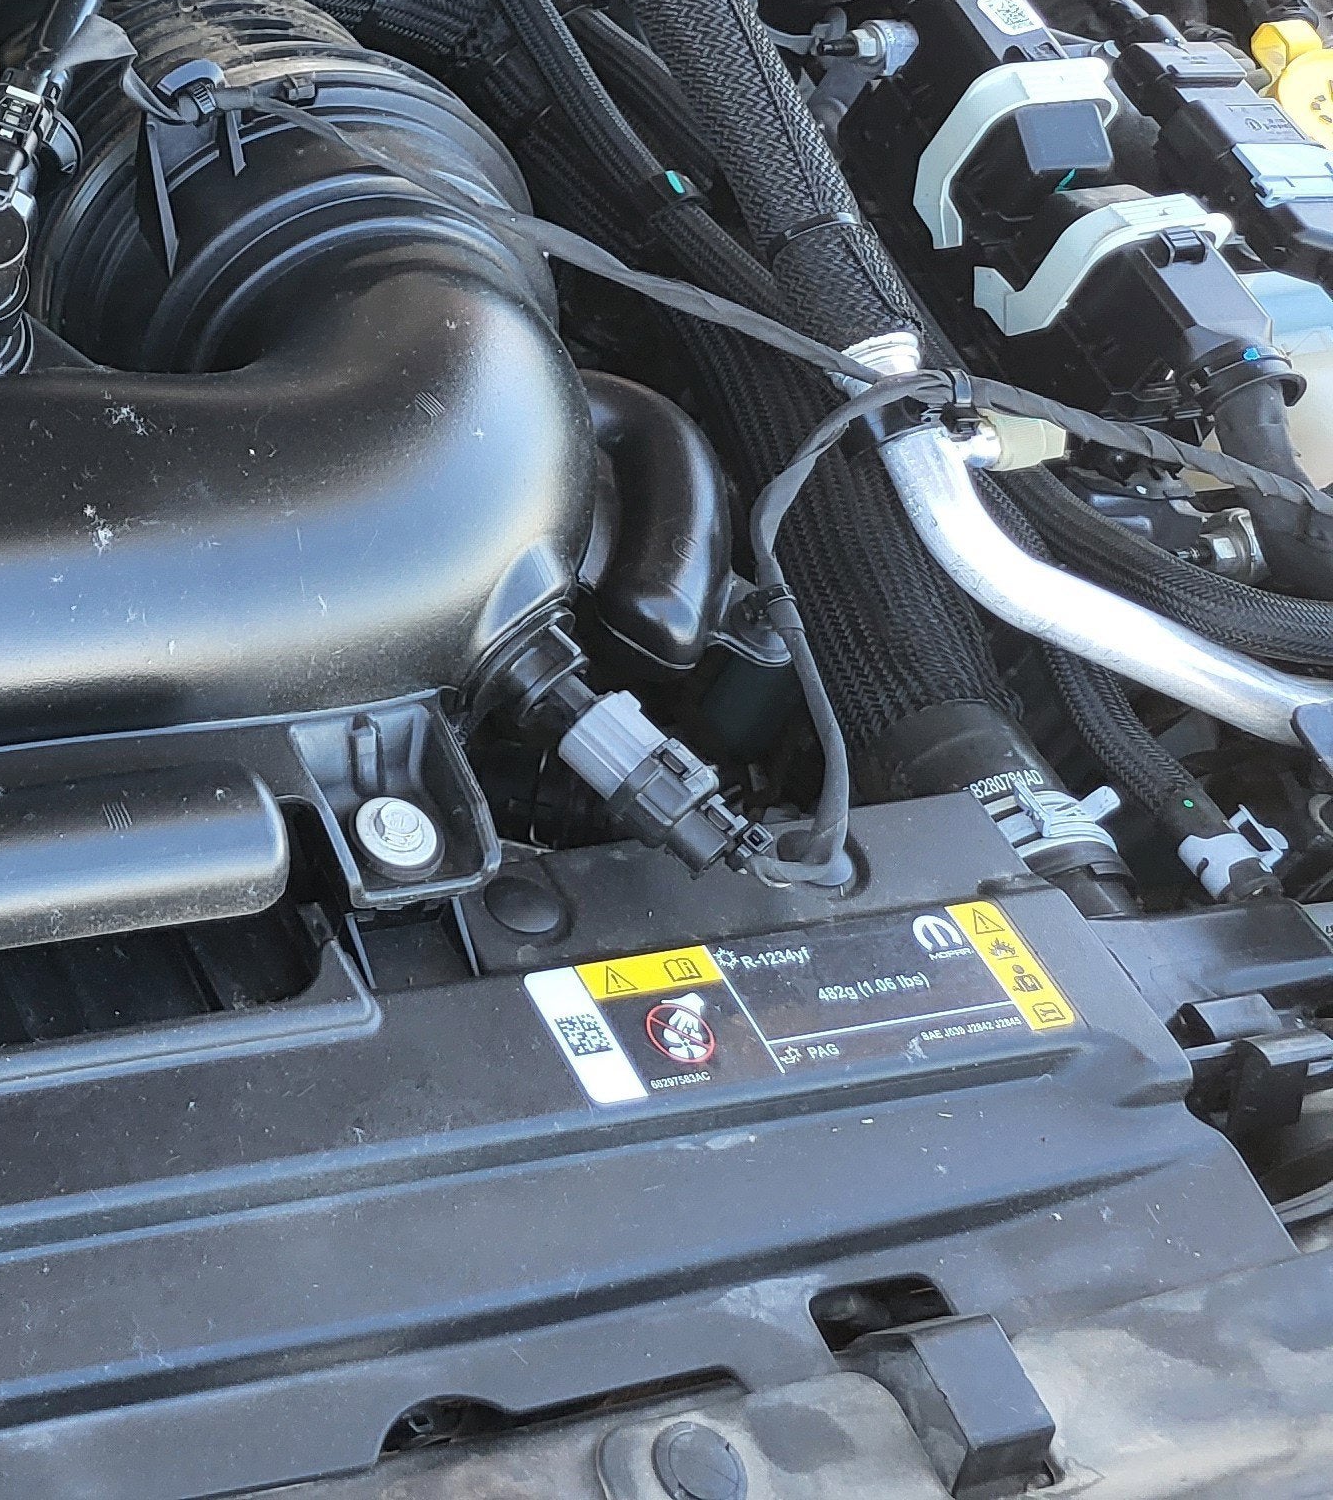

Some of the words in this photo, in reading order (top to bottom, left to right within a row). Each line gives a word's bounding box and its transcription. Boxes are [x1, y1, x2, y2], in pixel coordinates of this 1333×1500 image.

[962, 769, 1044, 800] 828071AD
[740, 945, 812, 971] R-1234yf
[817, 980, 860, 1003] 482g
[856, 975, 898, 1000] (1.06
[895, 971, 931, 995] lbs)
[806, 1041, 841, 1061] PAG
